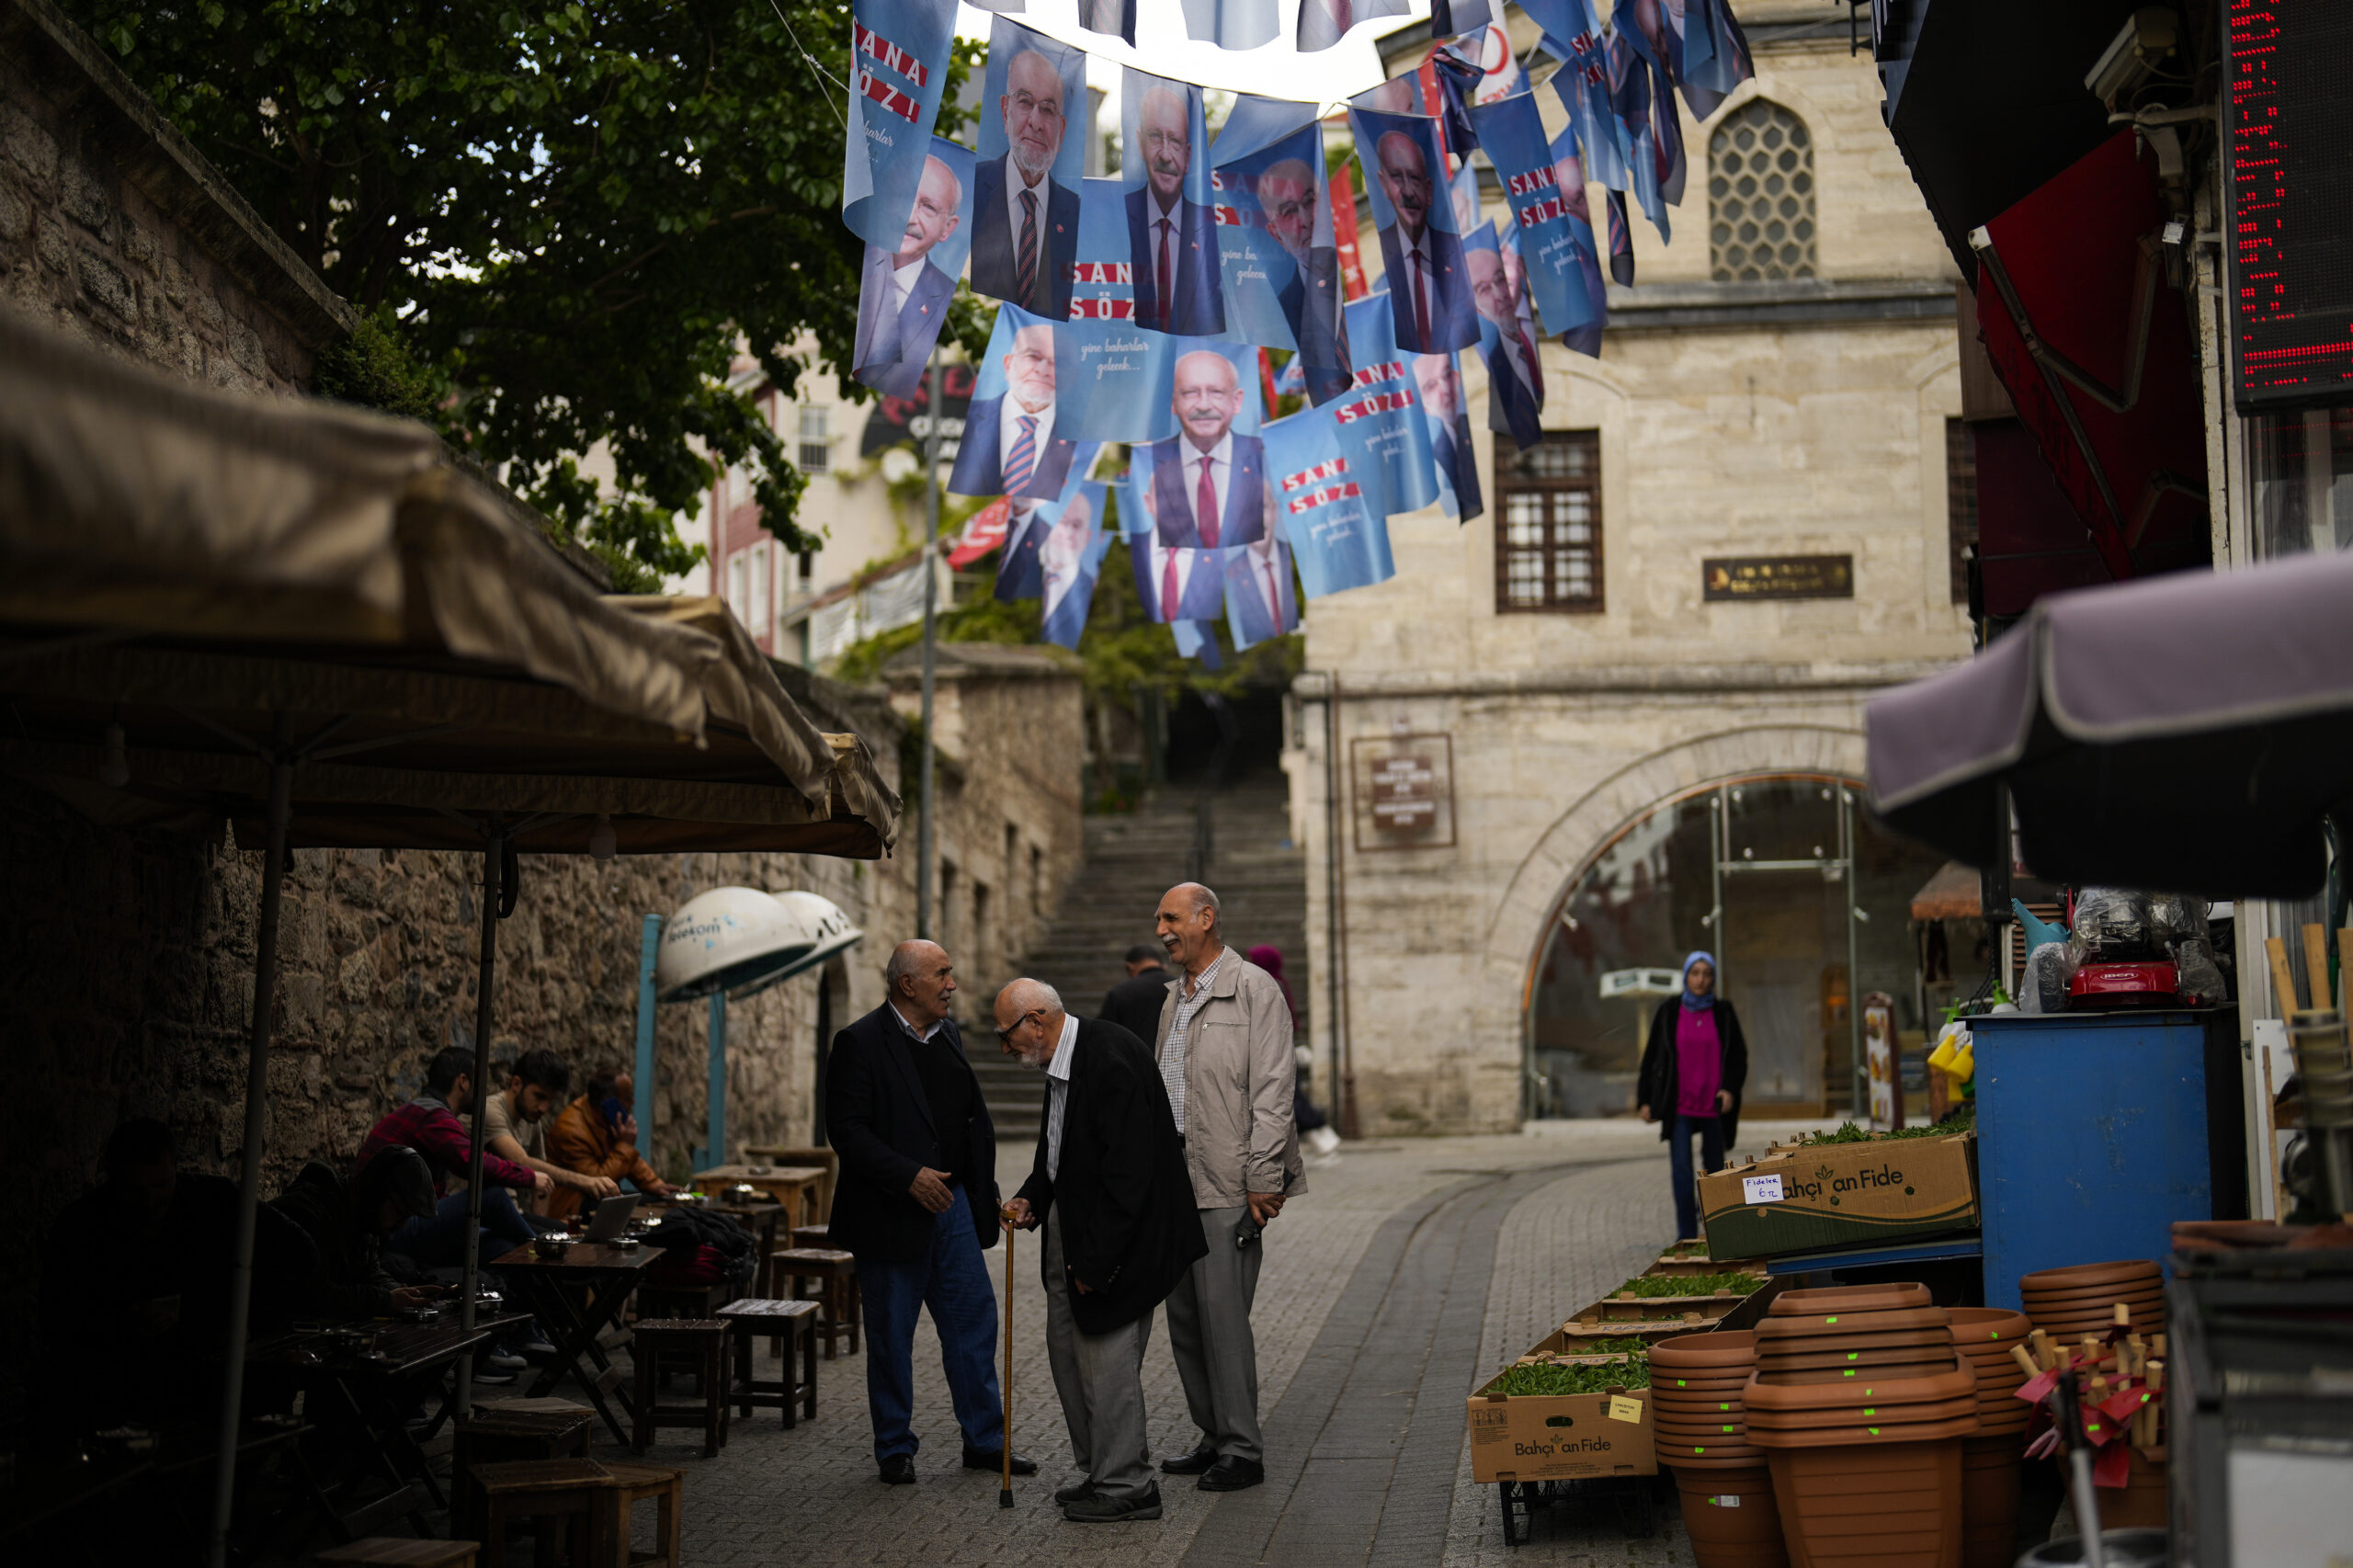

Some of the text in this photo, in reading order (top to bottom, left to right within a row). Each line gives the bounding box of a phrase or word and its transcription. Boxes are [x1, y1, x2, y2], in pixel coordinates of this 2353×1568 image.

[858, 63, 915, 123] ÖZ!
[864, 120, 894, 147] harlar
[1521, 196, 1566, 228] SÖZ
[1071, 261, 1133, 285] SAN
[1069, 290, 1136, 322] SÖZ
[1080, 336, 1150, 362] yine baharlar
[1349, 361, 1400, 392] ANA
[1339, 389, 1409, 424] SÖZ!
[1292, 483, 1353, 514] SÖZ
[1859, 1163, 1904, 1189] Fide
[1758, 1187, 1767, 1199] 6
[1580, 1435, 1611, 1452] Fide
